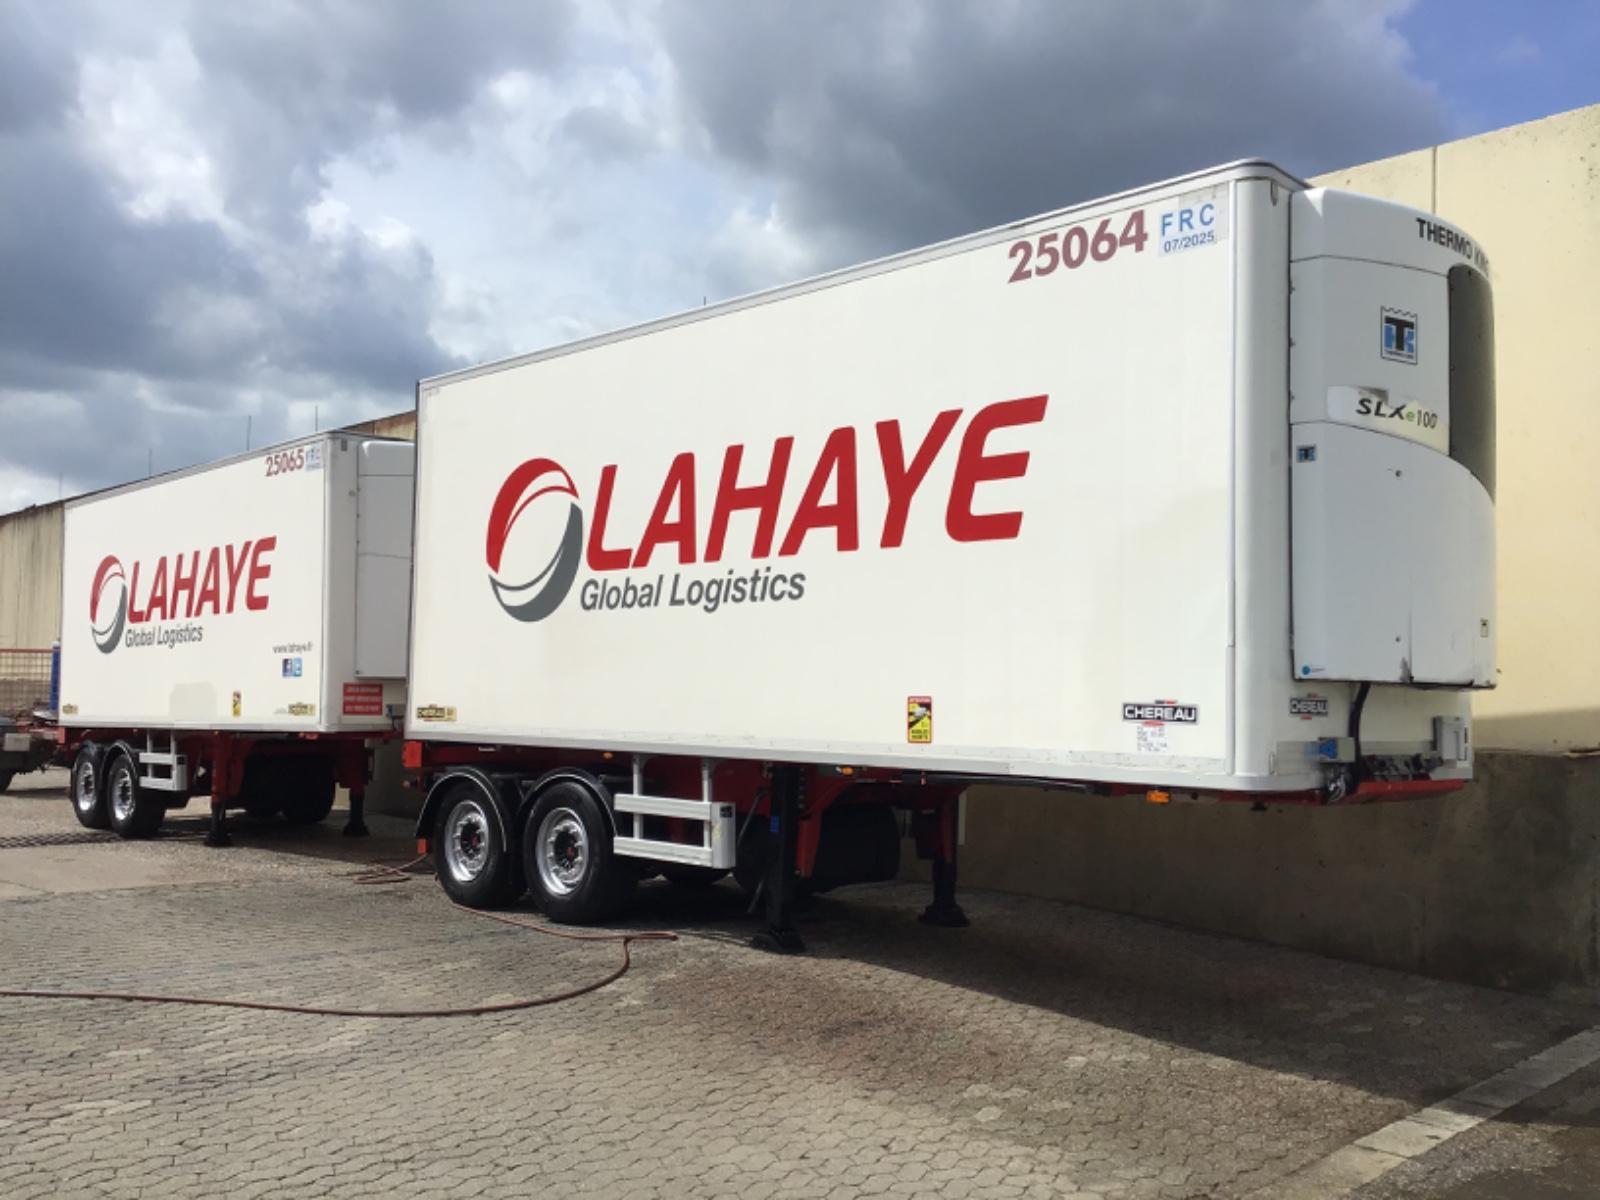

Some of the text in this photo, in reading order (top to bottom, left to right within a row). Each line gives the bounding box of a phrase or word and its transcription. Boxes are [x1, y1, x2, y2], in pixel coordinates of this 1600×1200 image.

[1008, 209, 1148, 284] 25064
[1163, 231, 1215, 253] 07/2025
[1415, 217, 1473, 260] THERMO
[265, 447, 304, 477] 25065
[580, 567, 806, 614] Global Logistics
[125, 622, 204, 649] Global Logistics
[1125, 705, 1196, 721] CHEREAU
